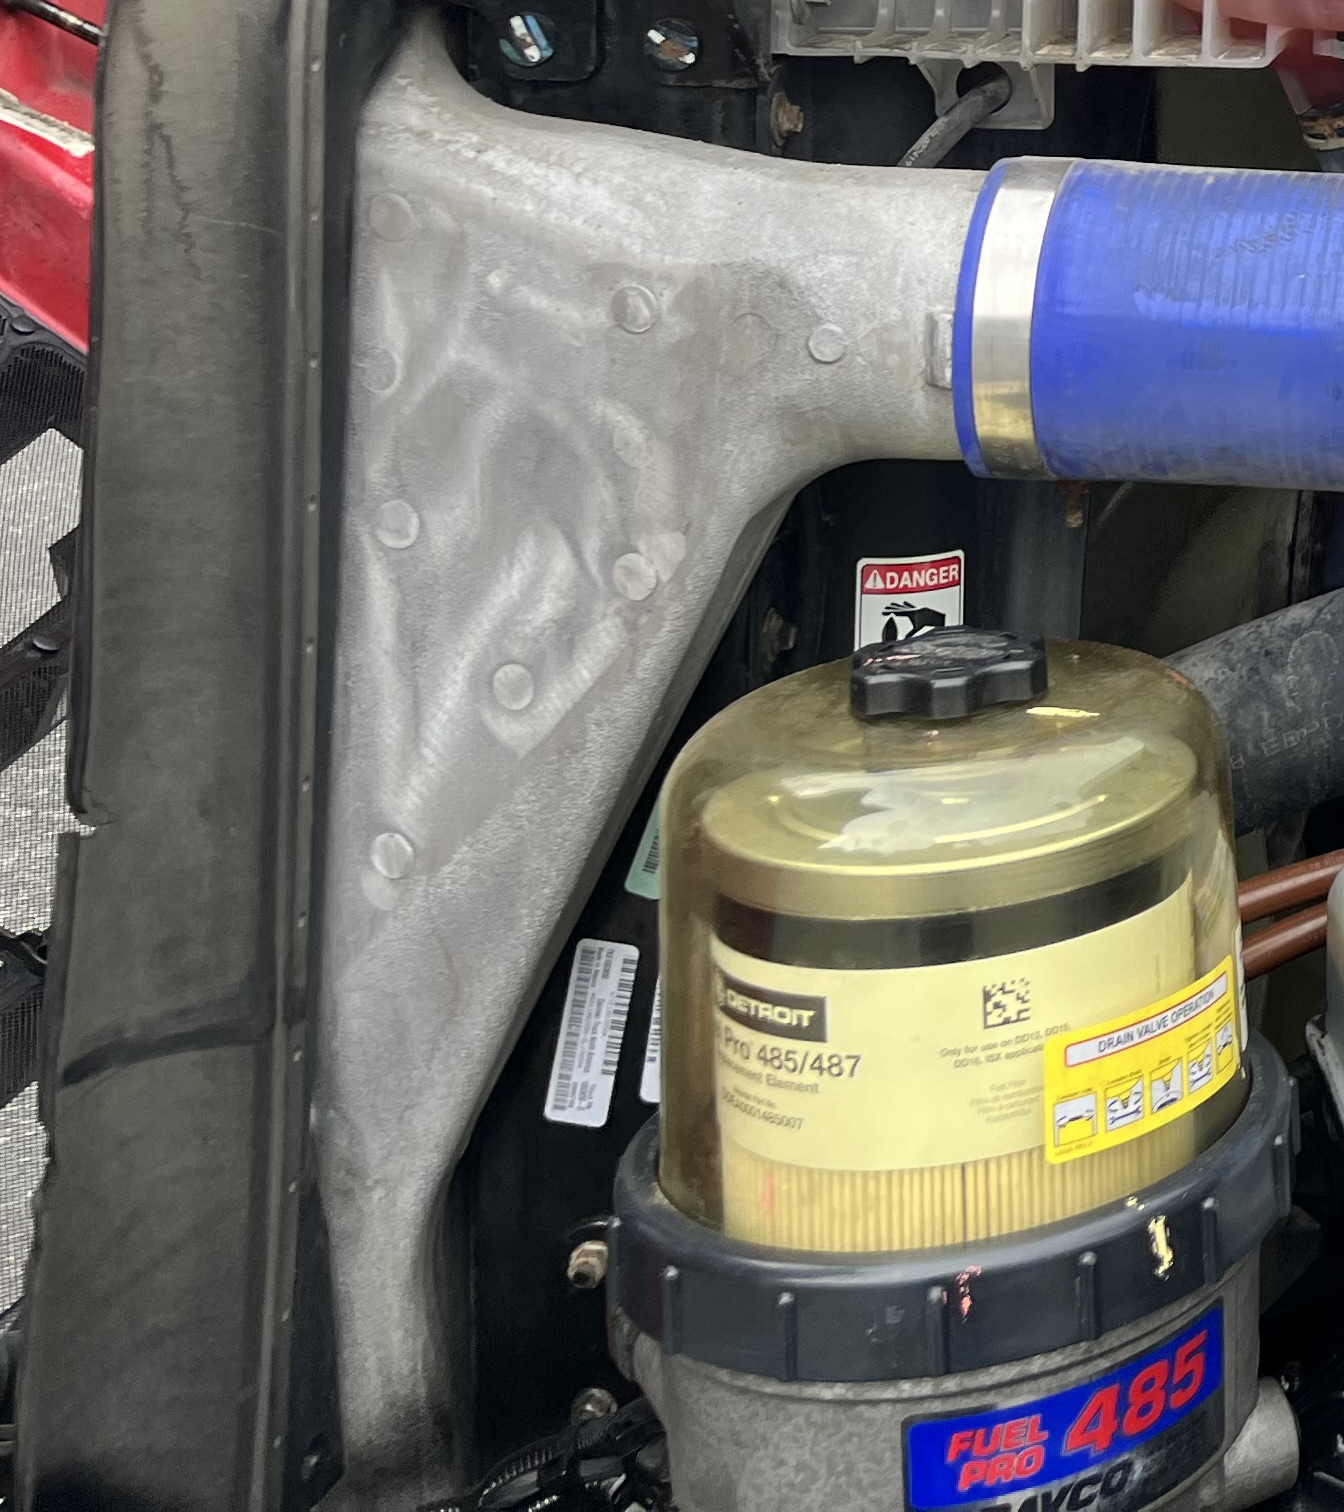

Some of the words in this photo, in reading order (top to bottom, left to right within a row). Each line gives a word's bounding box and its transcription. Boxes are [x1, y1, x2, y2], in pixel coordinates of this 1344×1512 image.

[885, 563, 960, 588] DANGER
[725, 988, 818, 1027] DETROIT
[1097, 1029, 1135, 1053] DRAIN
[1136, 1015, 1170, 1040] VALVE
[1170, 988, 1215, 1024] OPERATION
[724, 1026, 750, 1060] Pro
[756, 1044, 862, 1078] 485/487
[940, 1047, 962, 1058] Only
[963, 1044, 978, 1053] for
[980, 1042, 999, 1052] use
[1000, 1039, 1013, 1048] on
[766, 1073, 820, 1094] Element
[1062, 1328, 1209, 1457] 485
[947, 1413, 1050, 1463] FUEL
[957, 1444, 1046, 1493] PRO
